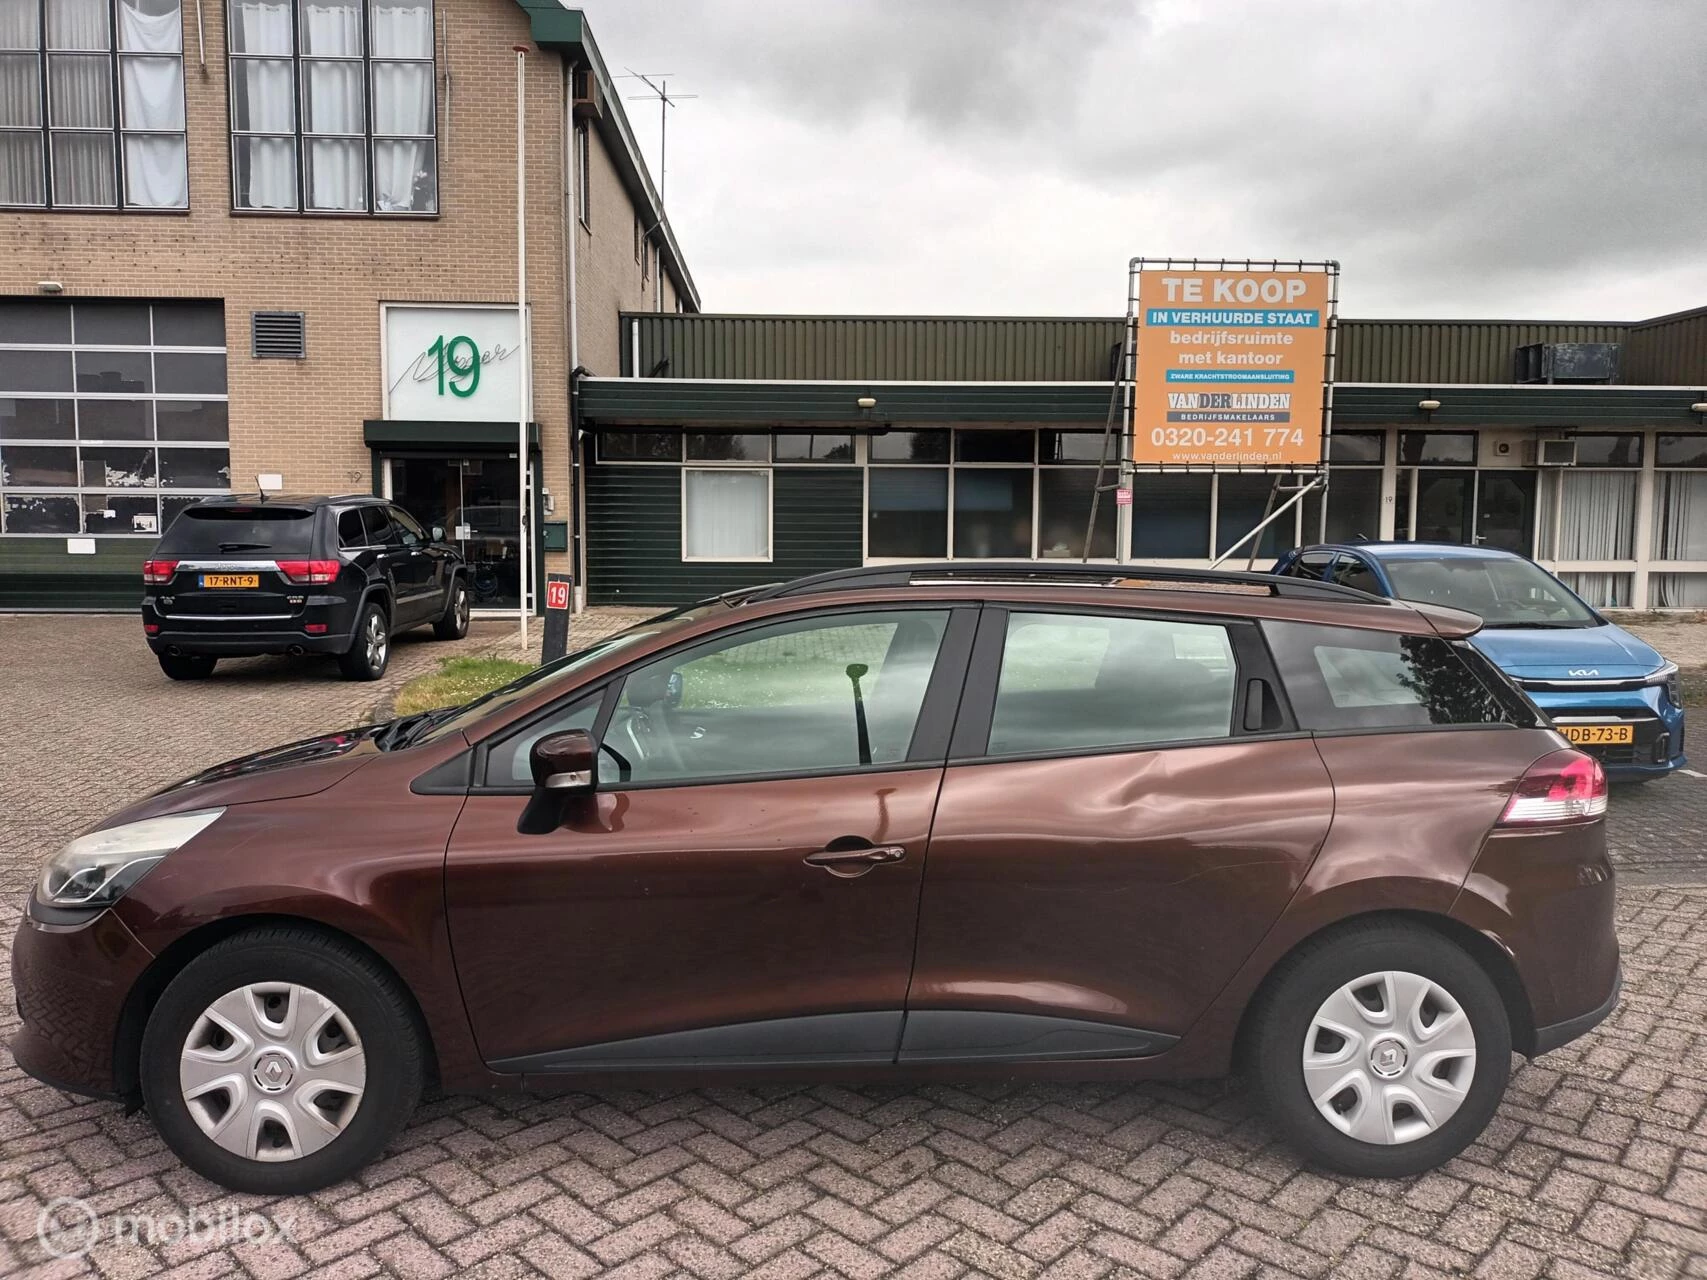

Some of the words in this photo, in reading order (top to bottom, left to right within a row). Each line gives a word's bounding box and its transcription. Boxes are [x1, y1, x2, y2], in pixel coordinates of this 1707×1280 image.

[1162, 278, 1203, 303] TE
[1213, 279, 1306, 304] KOOP
[1152, 312, 1168, 323] IN
[1171, 312, 1263, 324] VERHUURDE
[1267, 313, 1313, 324] STAAT
[1170, 330, 1294, 346] bedrijfsruimte
[427, 335, 480, 397] 19
[1179, 351, 1212, 365] met
[1216, 352, 1283, 365] kantoor
[1151, 428, 1254, 446] 0320-241
[1264, 428, 1304, 447] 774
[1172, 450, 1282, 461] www.vanderlinden.nl
[209, 576, 253, 586] 17-RNT-9
[551, 586, 566, 604] 19
